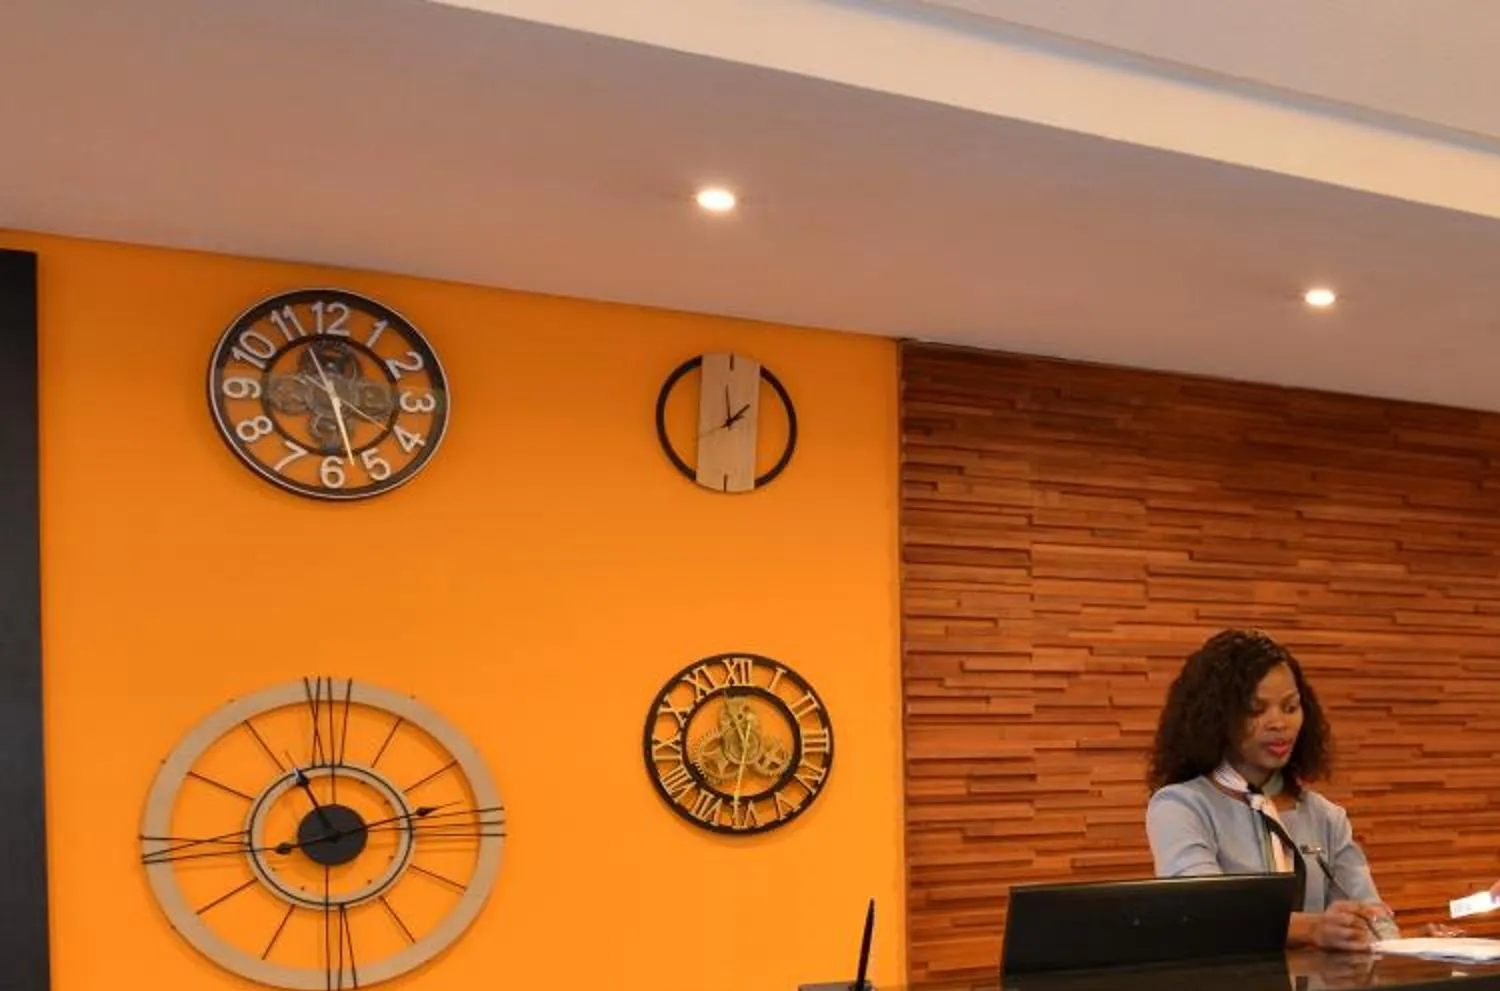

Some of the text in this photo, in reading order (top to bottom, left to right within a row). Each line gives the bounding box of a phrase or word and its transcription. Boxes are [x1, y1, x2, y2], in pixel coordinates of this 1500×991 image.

[270, 305, 308, 341] 11
[311, 301, 350, 336] 12
[365, 319, 389, 348] 1
[231, 331, 276, 368] 10
[385, 351, 424, 380] 2
[223, 376, 261, 399] 9
[400, 391, 436, 413] 3
[236, 415, 273, 443] 8
[393, 424, 426, 453] 4
[273, 440, 309, 472] 7
[361, 448, 391, 481] 5
[320, 455, 345, 489] 6
[681, 664, 718, 702] XI
[722, 658, 754, 687] XII
[767, 666, 788, 692] I
[657, 694, 694, 729] X
[789, 690, 821, 720] II
[652, 731, 682, 762] IX
[800, 727, 830, 754] III
[793, 759, 829, 796] IV
